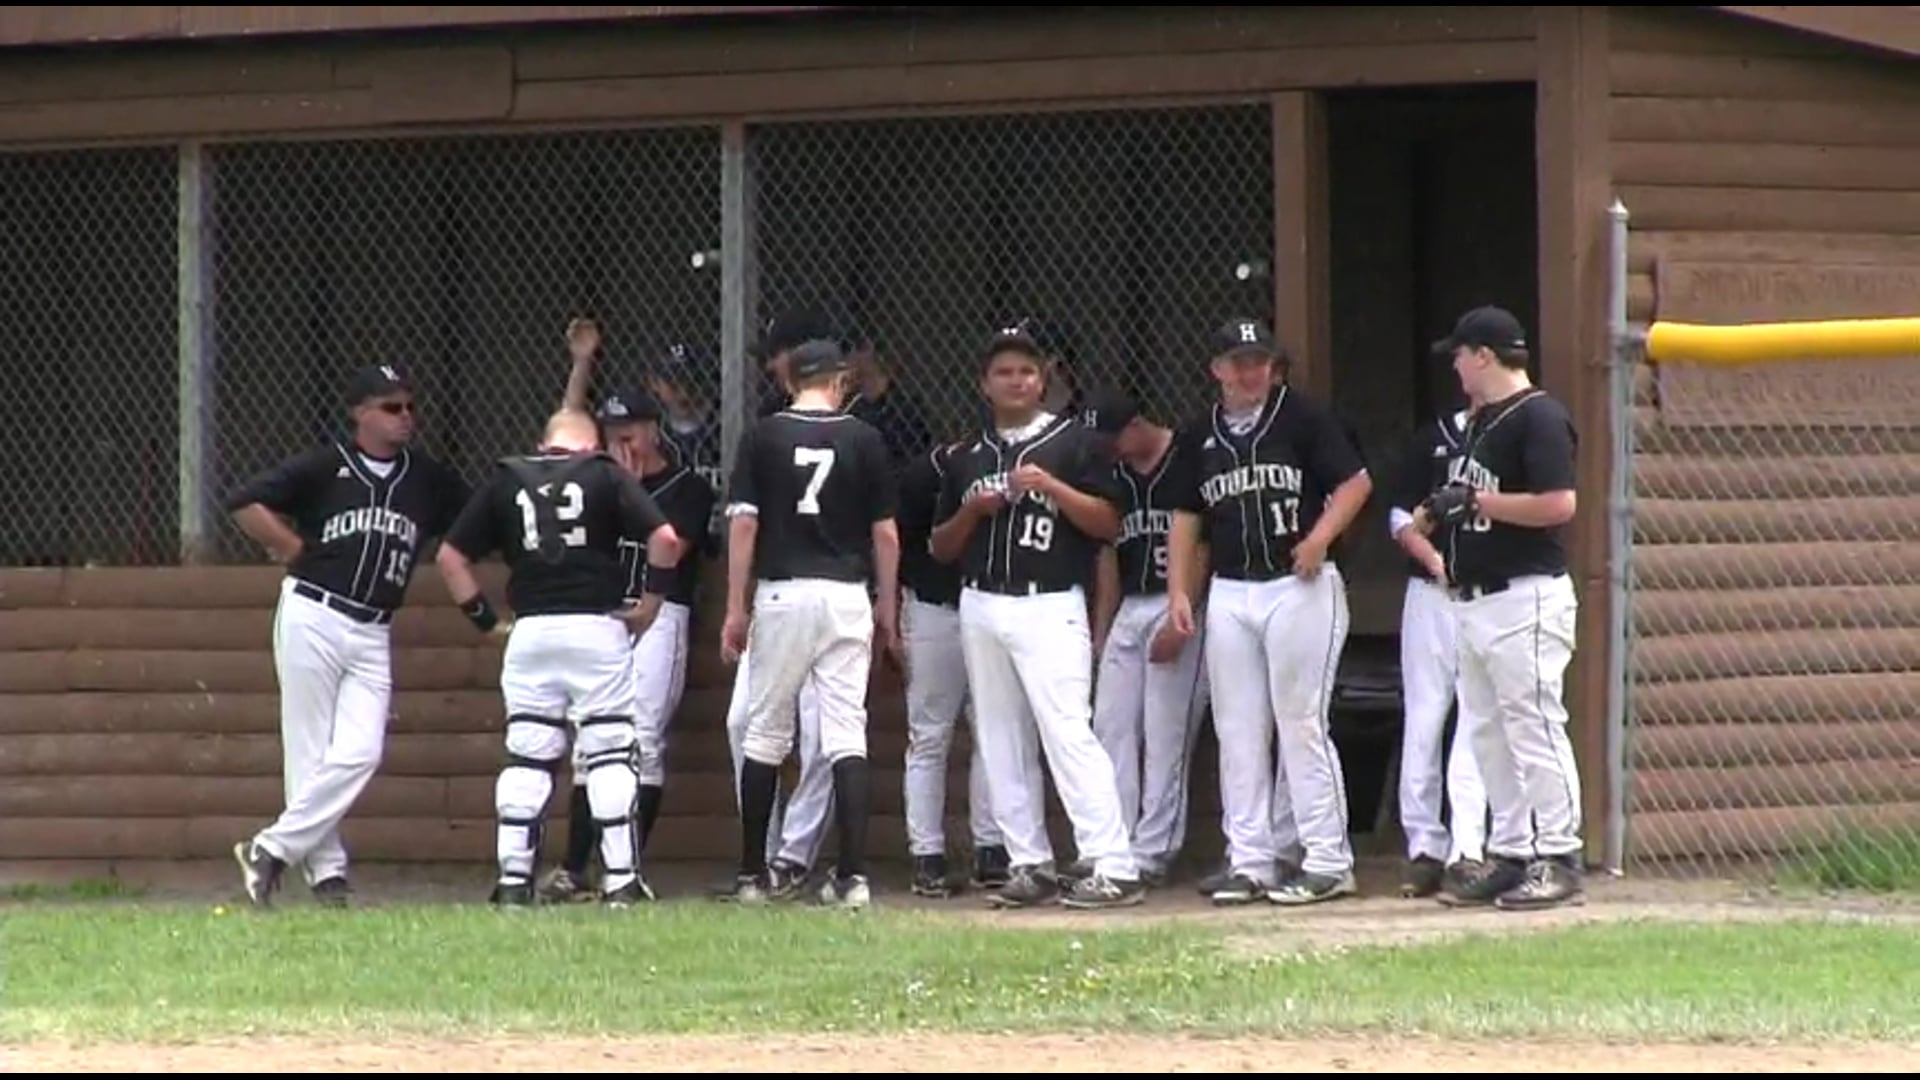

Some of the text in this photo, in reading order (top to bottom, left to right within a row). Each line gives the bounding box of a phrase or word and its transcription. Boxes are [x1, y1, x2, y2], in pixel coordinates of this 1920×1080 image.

[1239, 323, 1257, 341] H
[1083, 408, 1097, 428] H
[794, 447, 834, 514] 7
[1199, 463, 1302, 507] HOULTON
[1018, 515, 1053, 551] 19
[1269, 497, 1300, 536] 17
